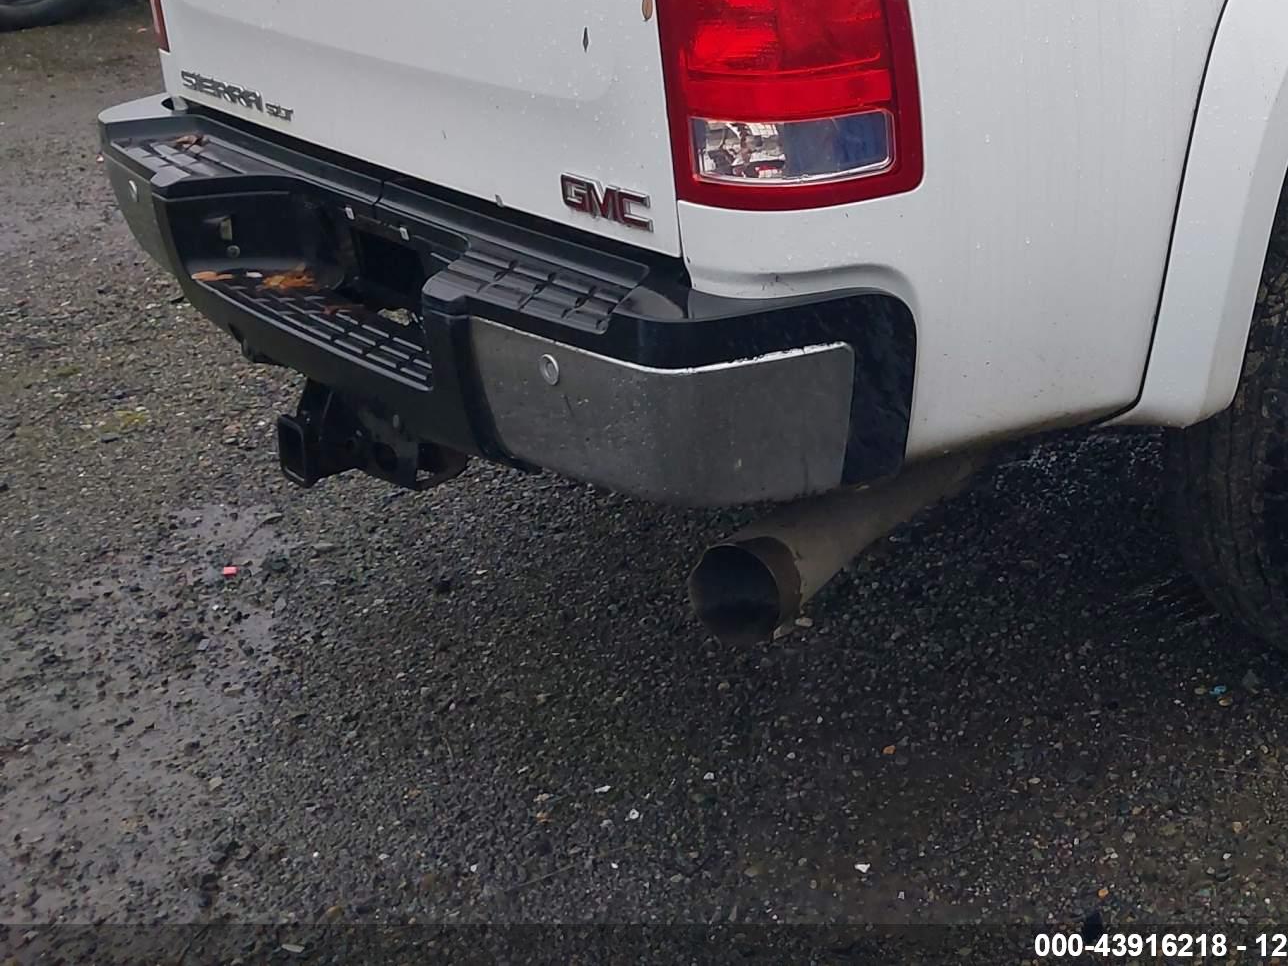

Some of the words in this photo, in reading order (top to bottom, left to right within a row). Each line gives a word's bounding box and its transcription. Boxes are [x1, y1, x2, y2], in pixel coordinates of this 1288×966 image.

[180, 70, 264, 113] SIERRA
[265, 102, 294, 122] SLT
[560, 172, 655, 233] GMC
